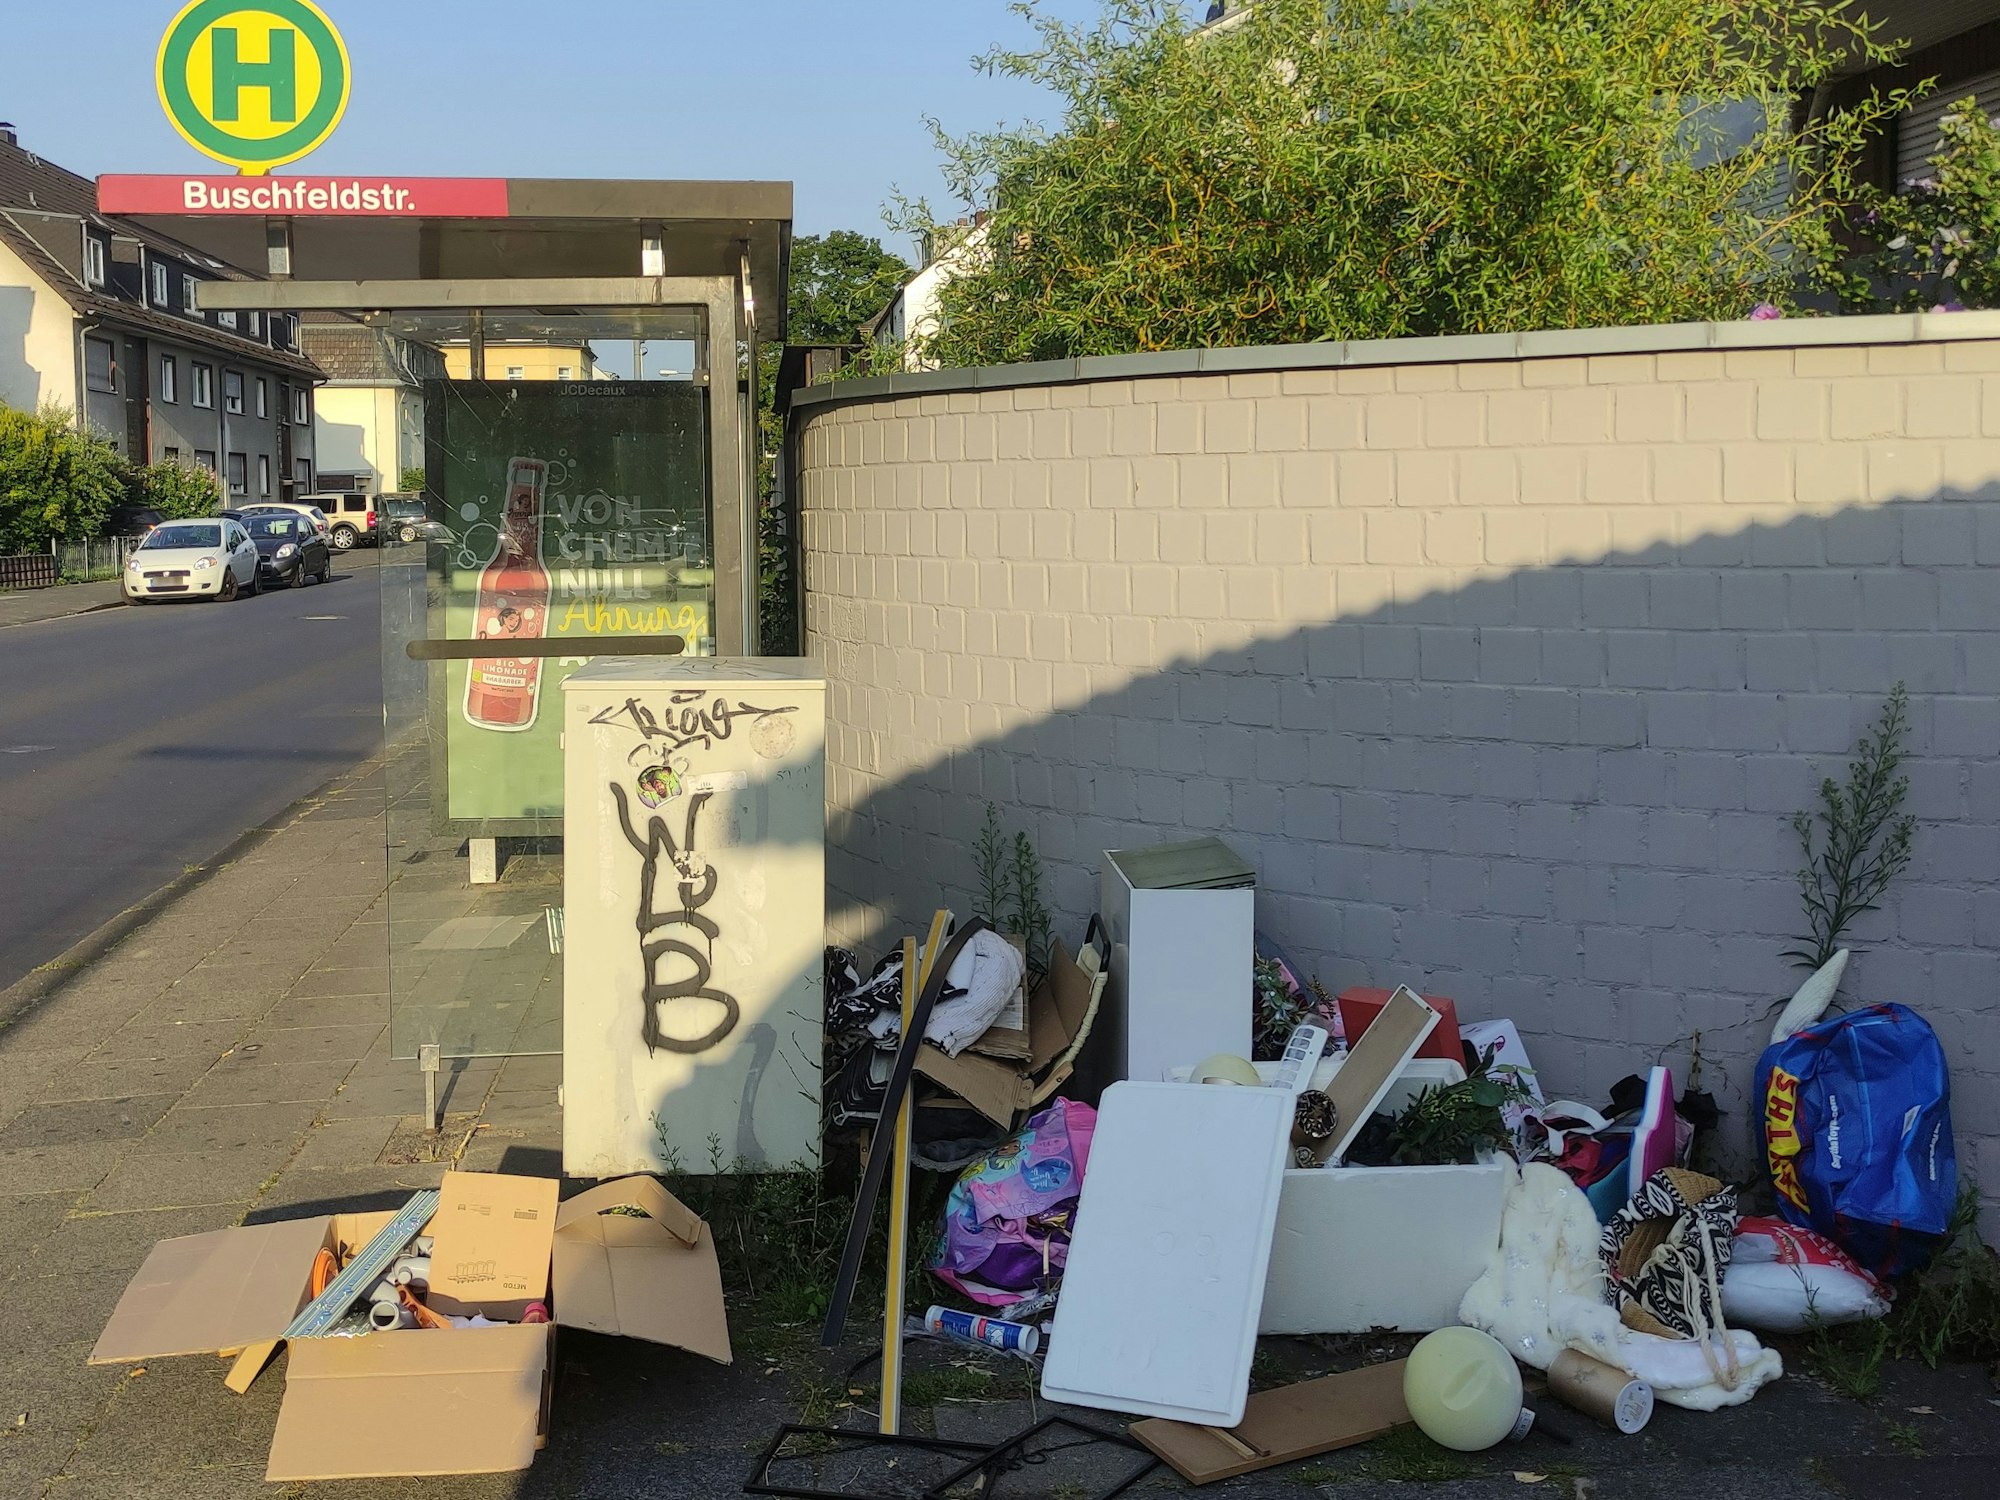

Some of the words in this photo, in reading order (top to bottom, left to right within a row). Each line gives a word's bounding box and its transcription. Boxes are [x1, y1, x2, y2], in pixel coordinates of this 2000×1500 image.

[211, 27, 296, 122] H
[183, 180, 416, 212] Buschfeldstr.
[560, 384, 627, 397] JCDecaux
[557, 494, 641, 525] VON
[558, 531, 702, 562] CHEMIE
[559, 568, 651, 598] NULL
[558, 597, 706, 643] Ahnung
[482, 664, 528, 676] LIMONADE
[496, 659, 515, 667] BIO
[502, 1282, 527, 1290] METOD
